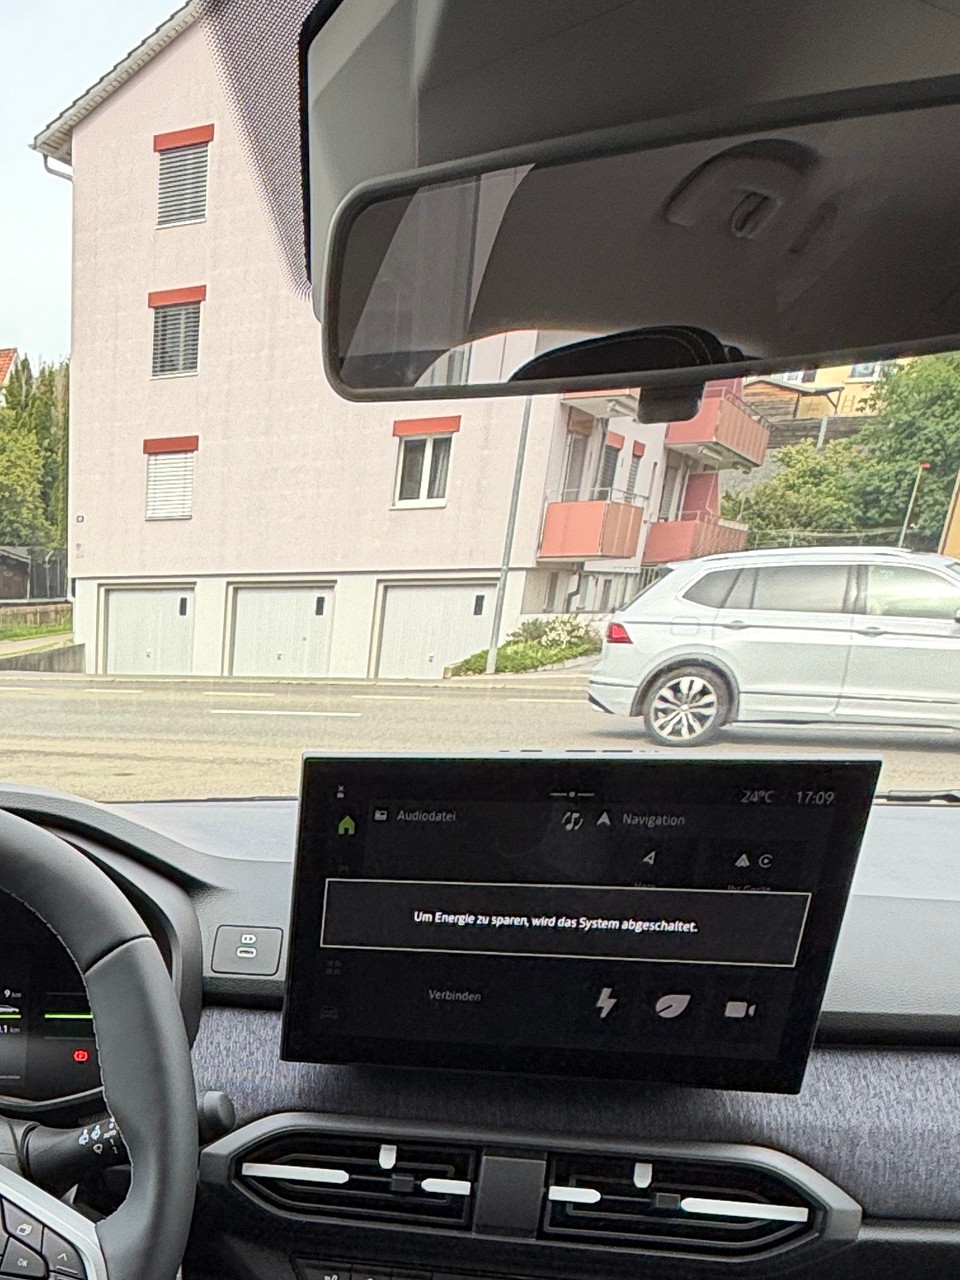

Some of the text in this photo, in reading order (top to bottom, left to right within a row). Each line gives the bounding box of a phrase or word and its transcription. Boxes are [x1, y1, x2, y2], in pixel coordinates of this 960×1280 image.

[795, 791, 835, 805] 17:09
[396, 809, 457, 823] Audiodatei
[622, 812, 686, 827] Navigation
[414, 911, 698, 932] Um Energie zu sparen, wird das System abgeschaltet.
[3, 989, 11, 998] 9
[428, 988, 482, 1002] Verbinden
